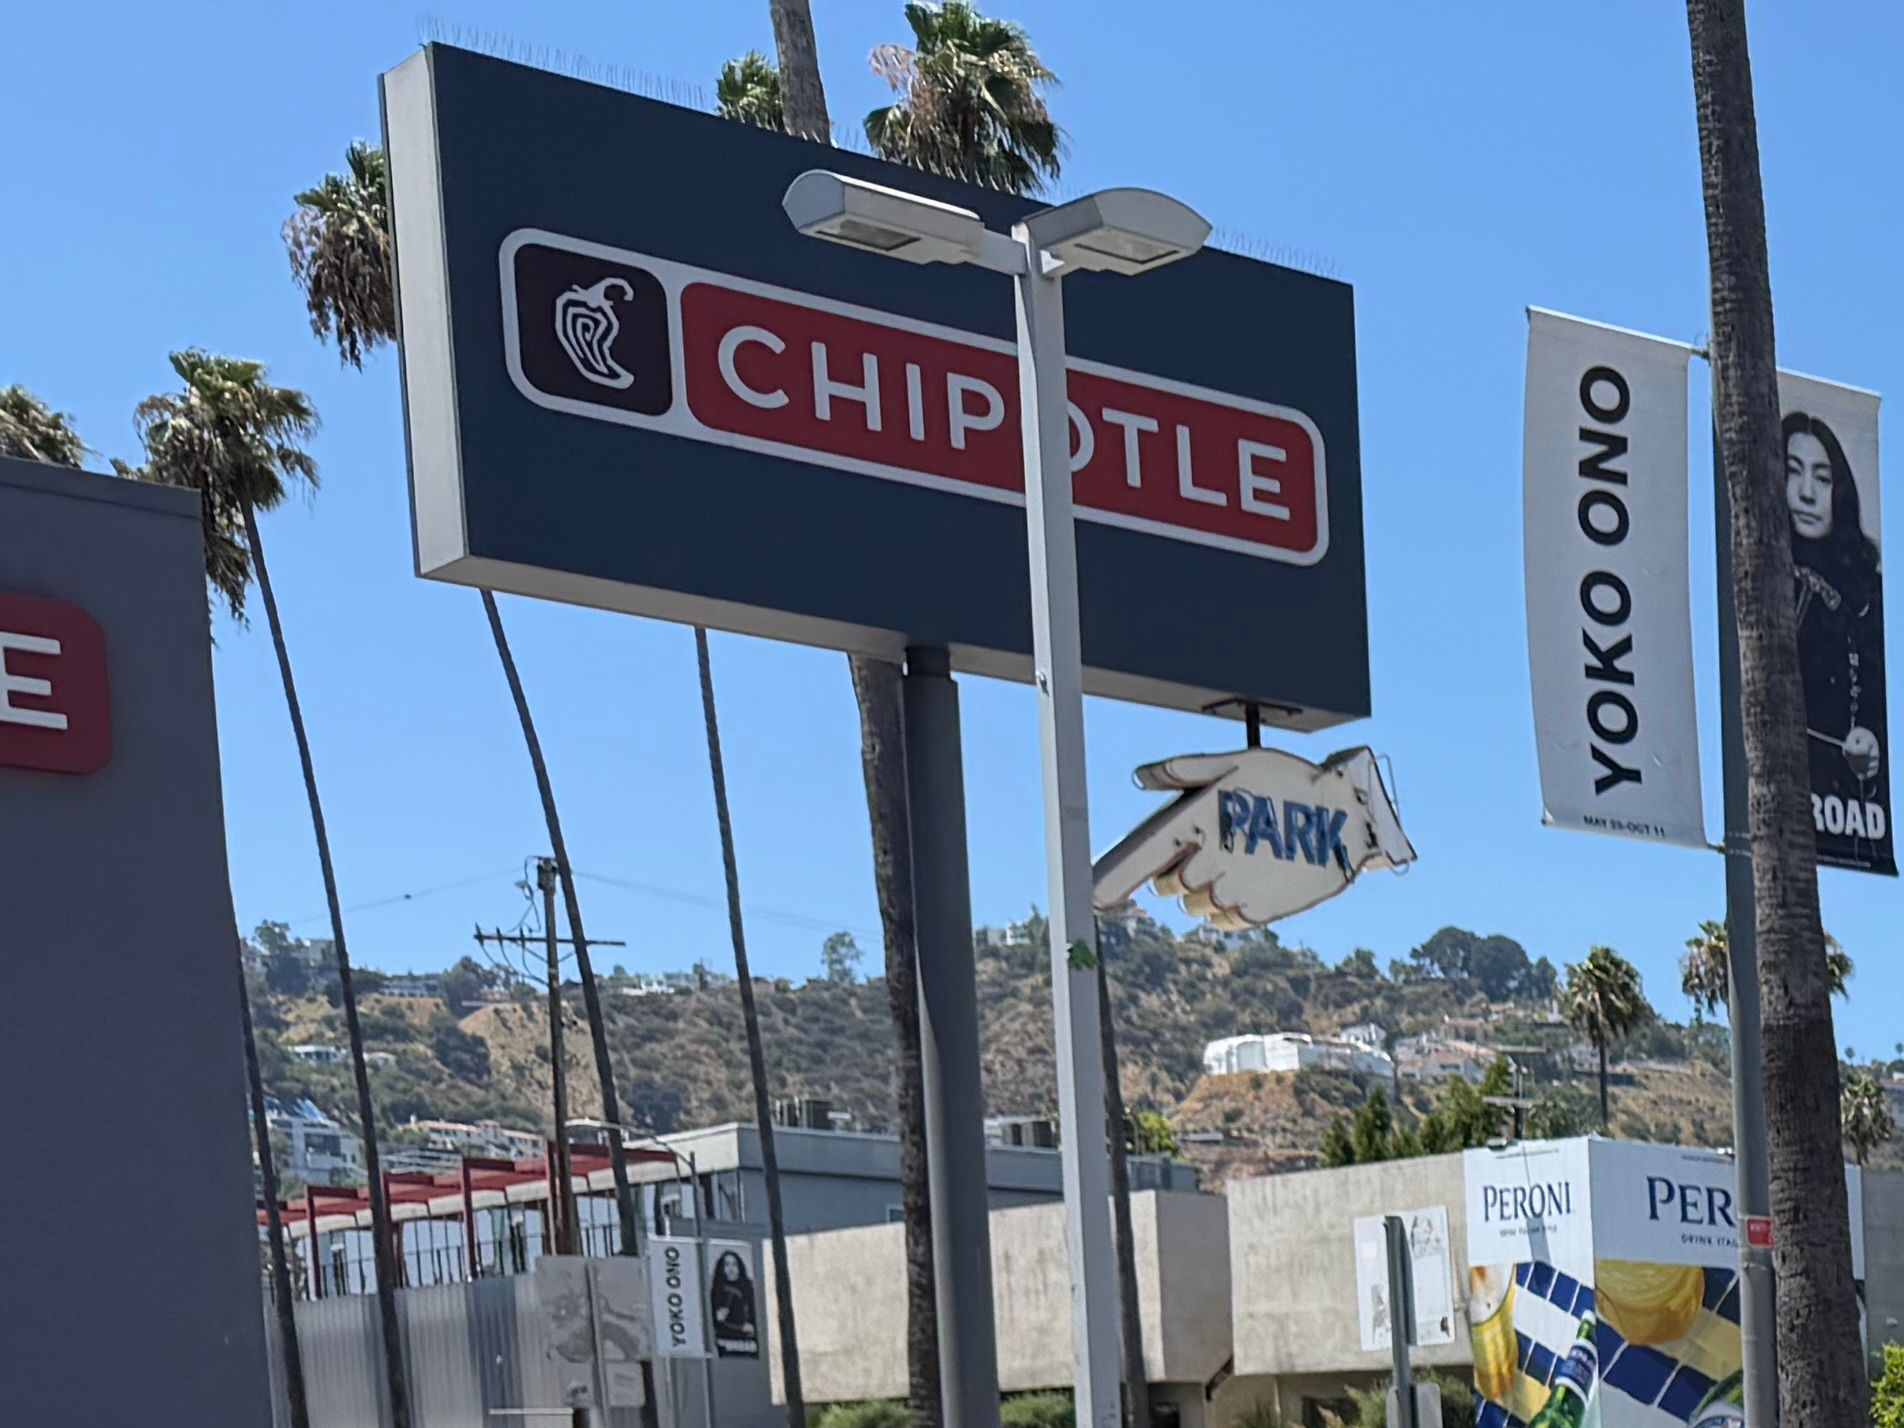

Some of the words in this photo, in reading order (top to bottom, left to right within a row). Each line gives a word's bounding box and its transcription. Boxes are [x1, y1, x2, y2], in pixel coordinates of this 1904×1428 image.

[1577, 365, 1631, 546] ONO
[1579, 569, 1642, 797] YOKO
[1217, 788, 1354, 884] PARK
[1483, 1181, 1571, 1222] PERONI
[664, 1246, 681, 1289] ONO
[667, 1293, 686, 1347] YOKO
